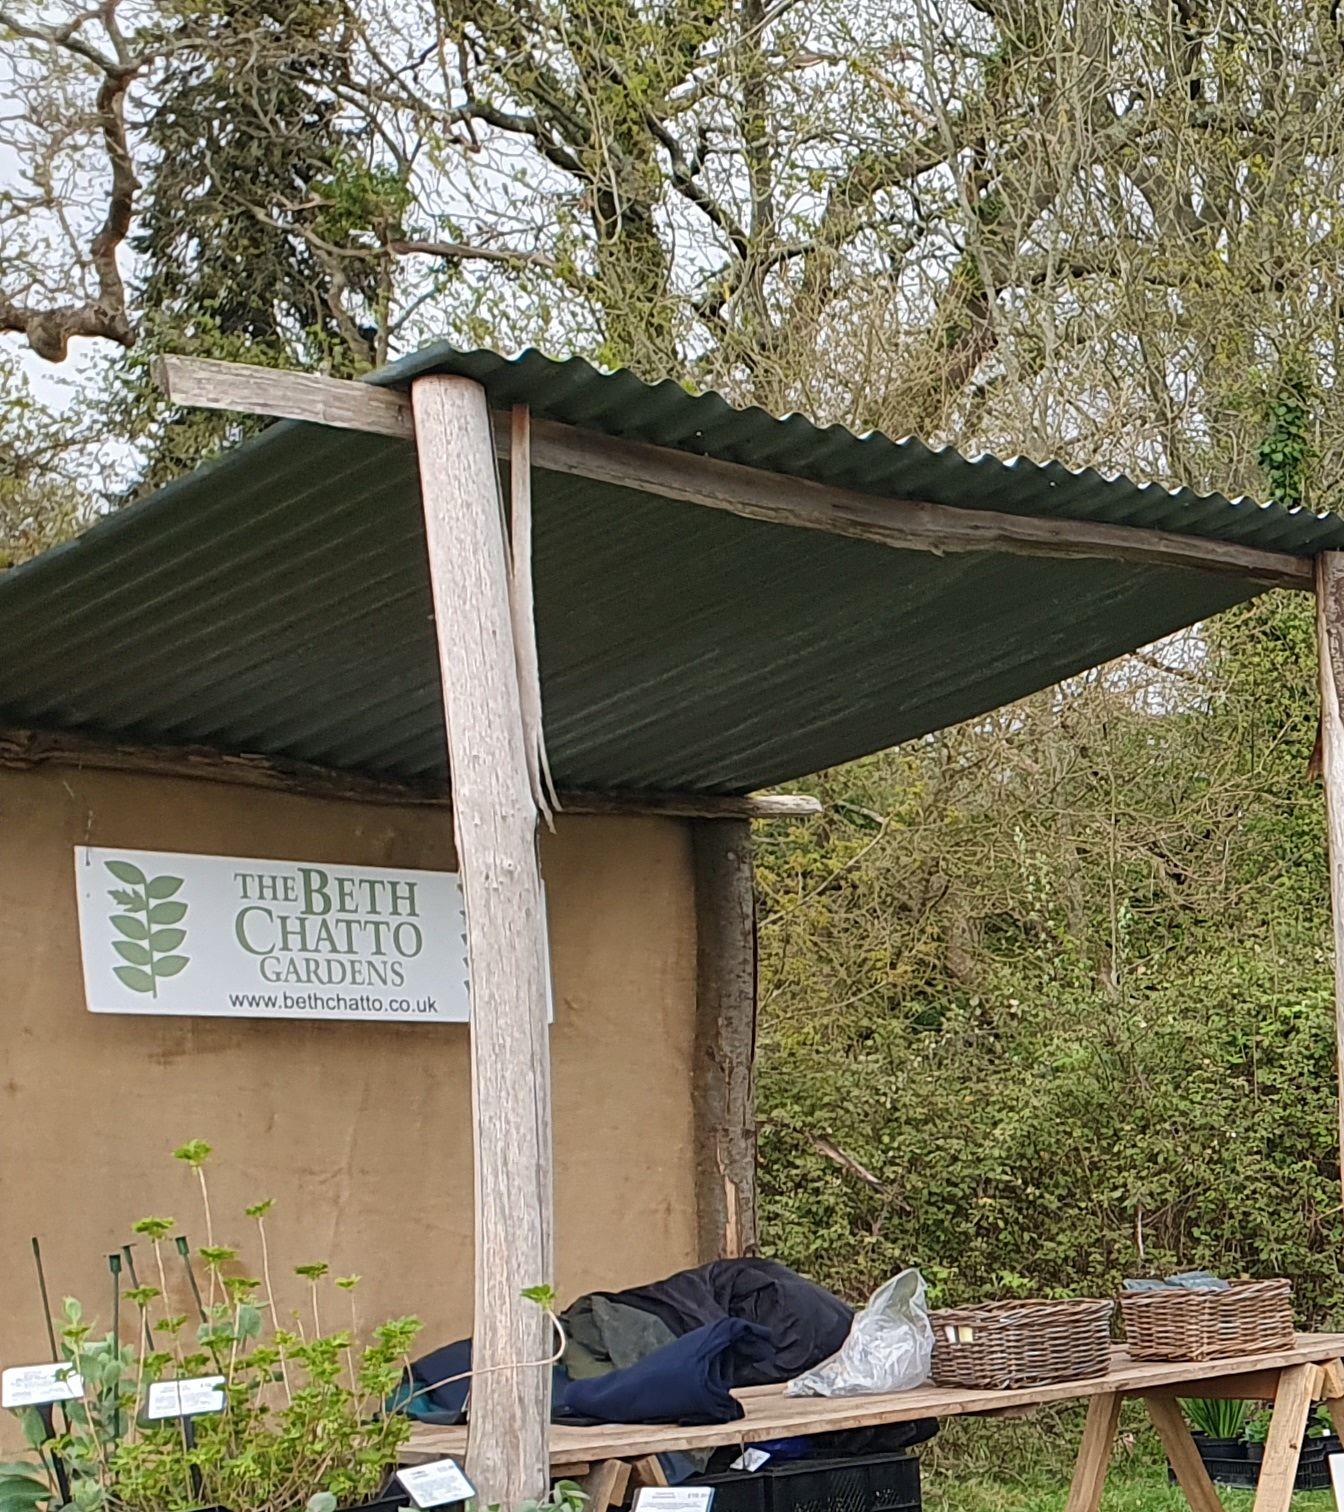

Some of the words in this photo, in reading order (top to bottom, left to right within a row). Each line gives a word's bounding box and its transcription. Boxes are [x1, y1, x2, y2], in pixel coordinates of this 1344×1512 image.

[234, 872, 298, 902] THE
[297, 867, 420, 918] BETH
[235, 906, 424, 958] CHATTO
[259, 955, 405, 987] GARDENS
[228, 992, 439, 1014] www.bethchatto.co.uk
